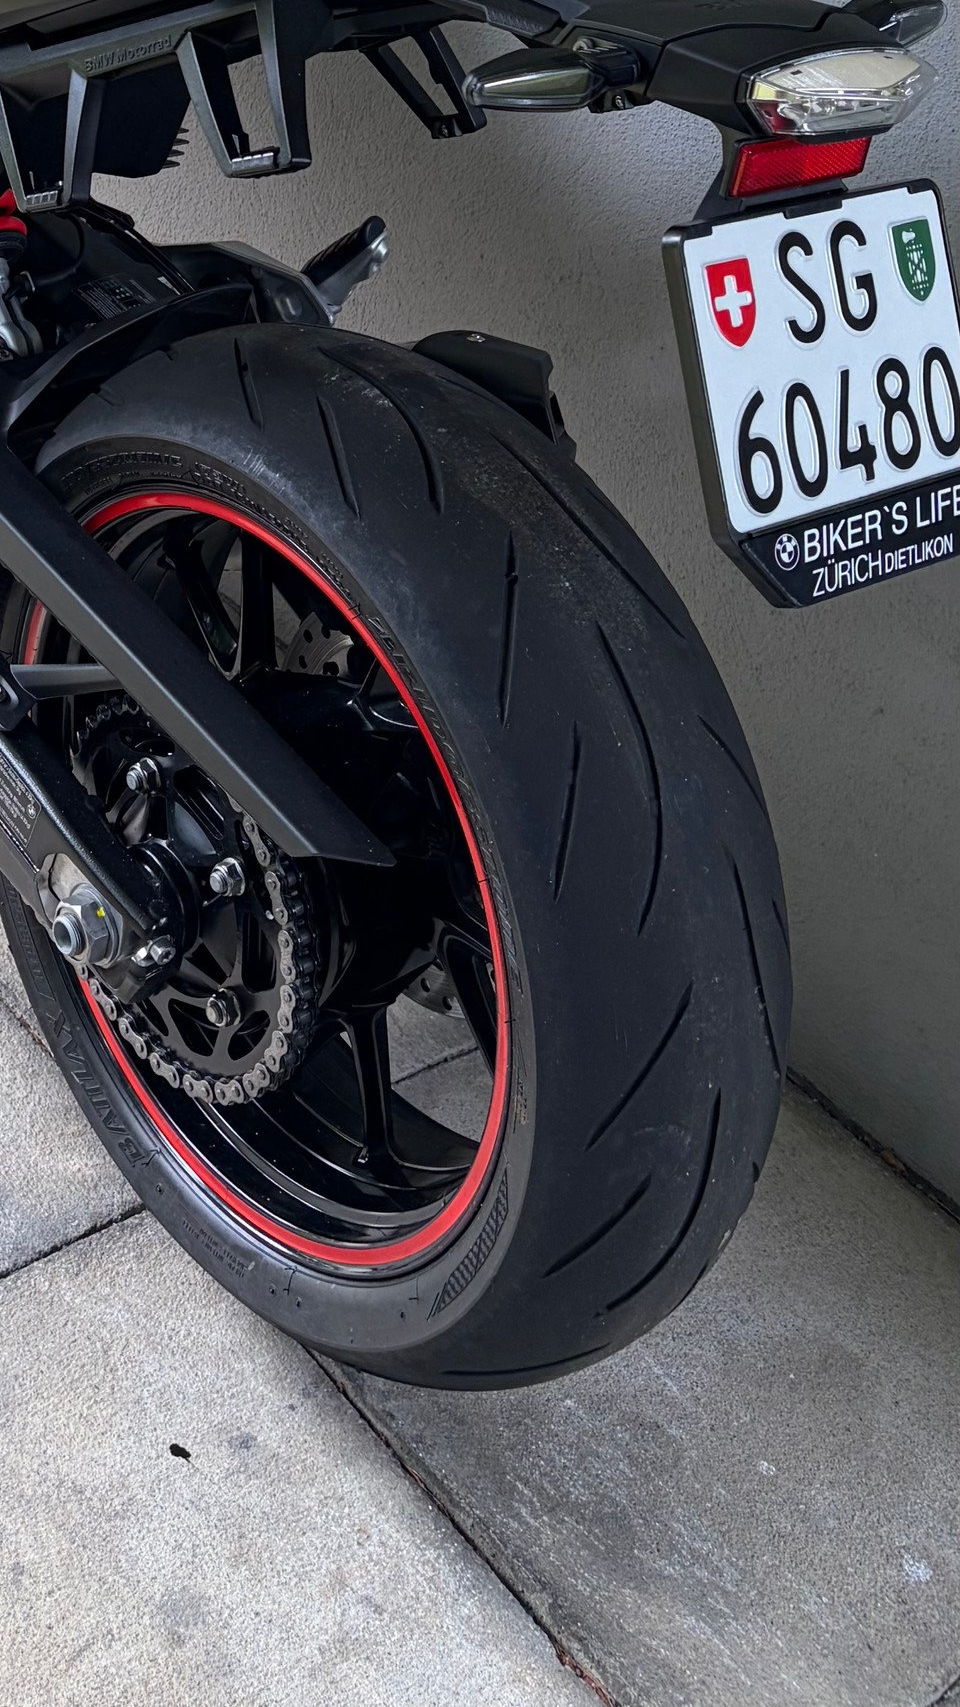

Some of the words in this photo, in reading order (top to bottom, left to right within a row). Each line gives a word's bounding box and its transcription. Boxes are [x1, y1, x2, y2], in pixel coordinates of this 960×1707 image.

[84, 51, 115, 72] BMW
[117, 34, 172, 63] Motorrad
[777, 220, 878, 344] SG
[738, 346, 960, 514] 60480
[812, 549, 883, 597] ZÜRICH
[884, 532, 954, 574] DIETLIKON
[46, 1010, 147, 1168] BATTLAX
